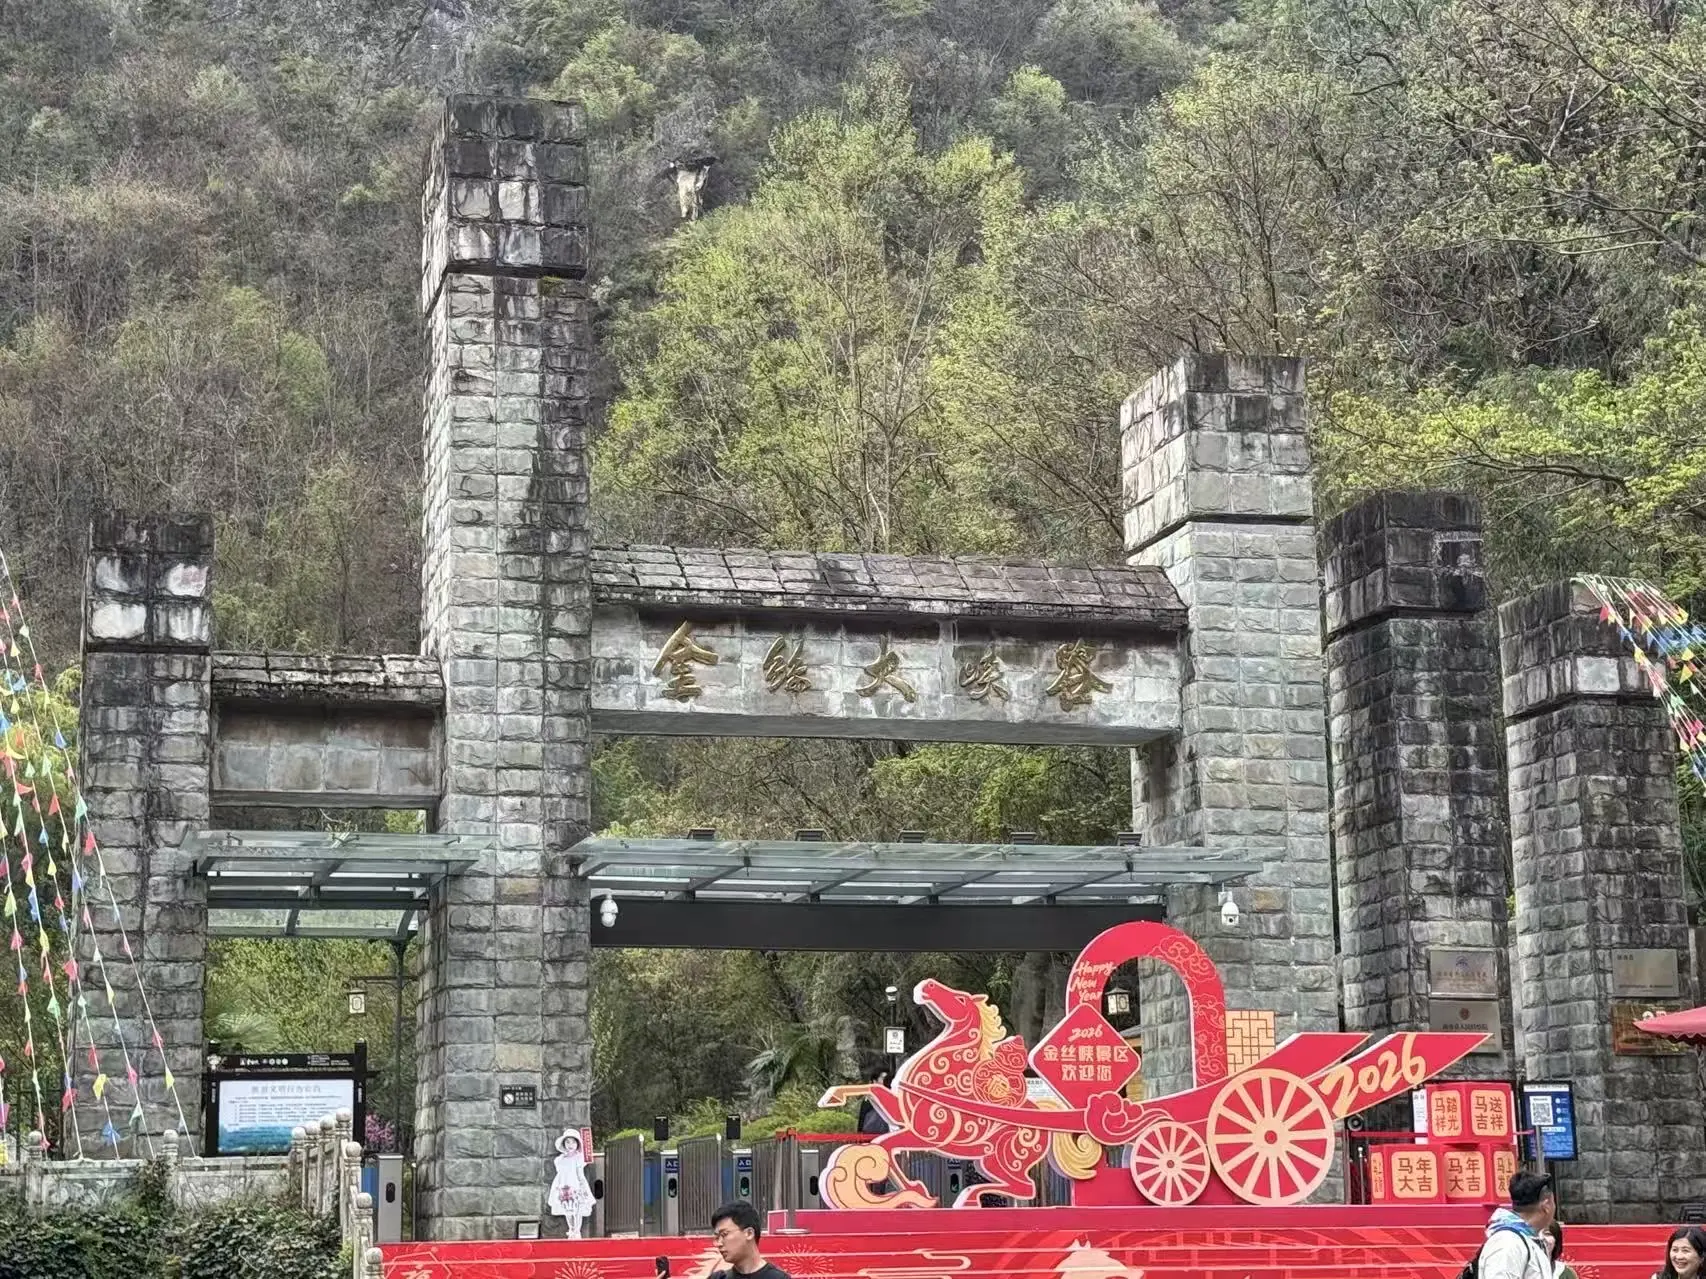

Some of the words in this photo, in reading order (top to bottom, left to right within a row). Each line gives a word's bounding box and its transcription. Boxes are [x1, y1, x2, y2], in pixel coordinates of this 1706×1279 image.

[1075, 960, 1116, 976] Happy
[1069, 976, 1097, 992] New
[1079, 990, 1102, 1004] Year
[1067, 1024, 1103, 1042] 2026
[1043, 1044, 1129, 1063] 金丝峡景区
[1318, 1032, 1427, 1117] 2026
[1434, 1096, 1458, 1113] 马踏
[1474, 1095, 1503, 1113] 马送
[1435, 1114, 1460, 1132] 祥光
[1475, 1113, 1504, 1130] 吉祥
[1398, 1157, 1432, 1174] 马年
[1448, 1157, 1480, 1174] 马年
[1398, 1175, 1432, 1192] 大吉
[1449, 1175, 1481, 1192] 大吉
